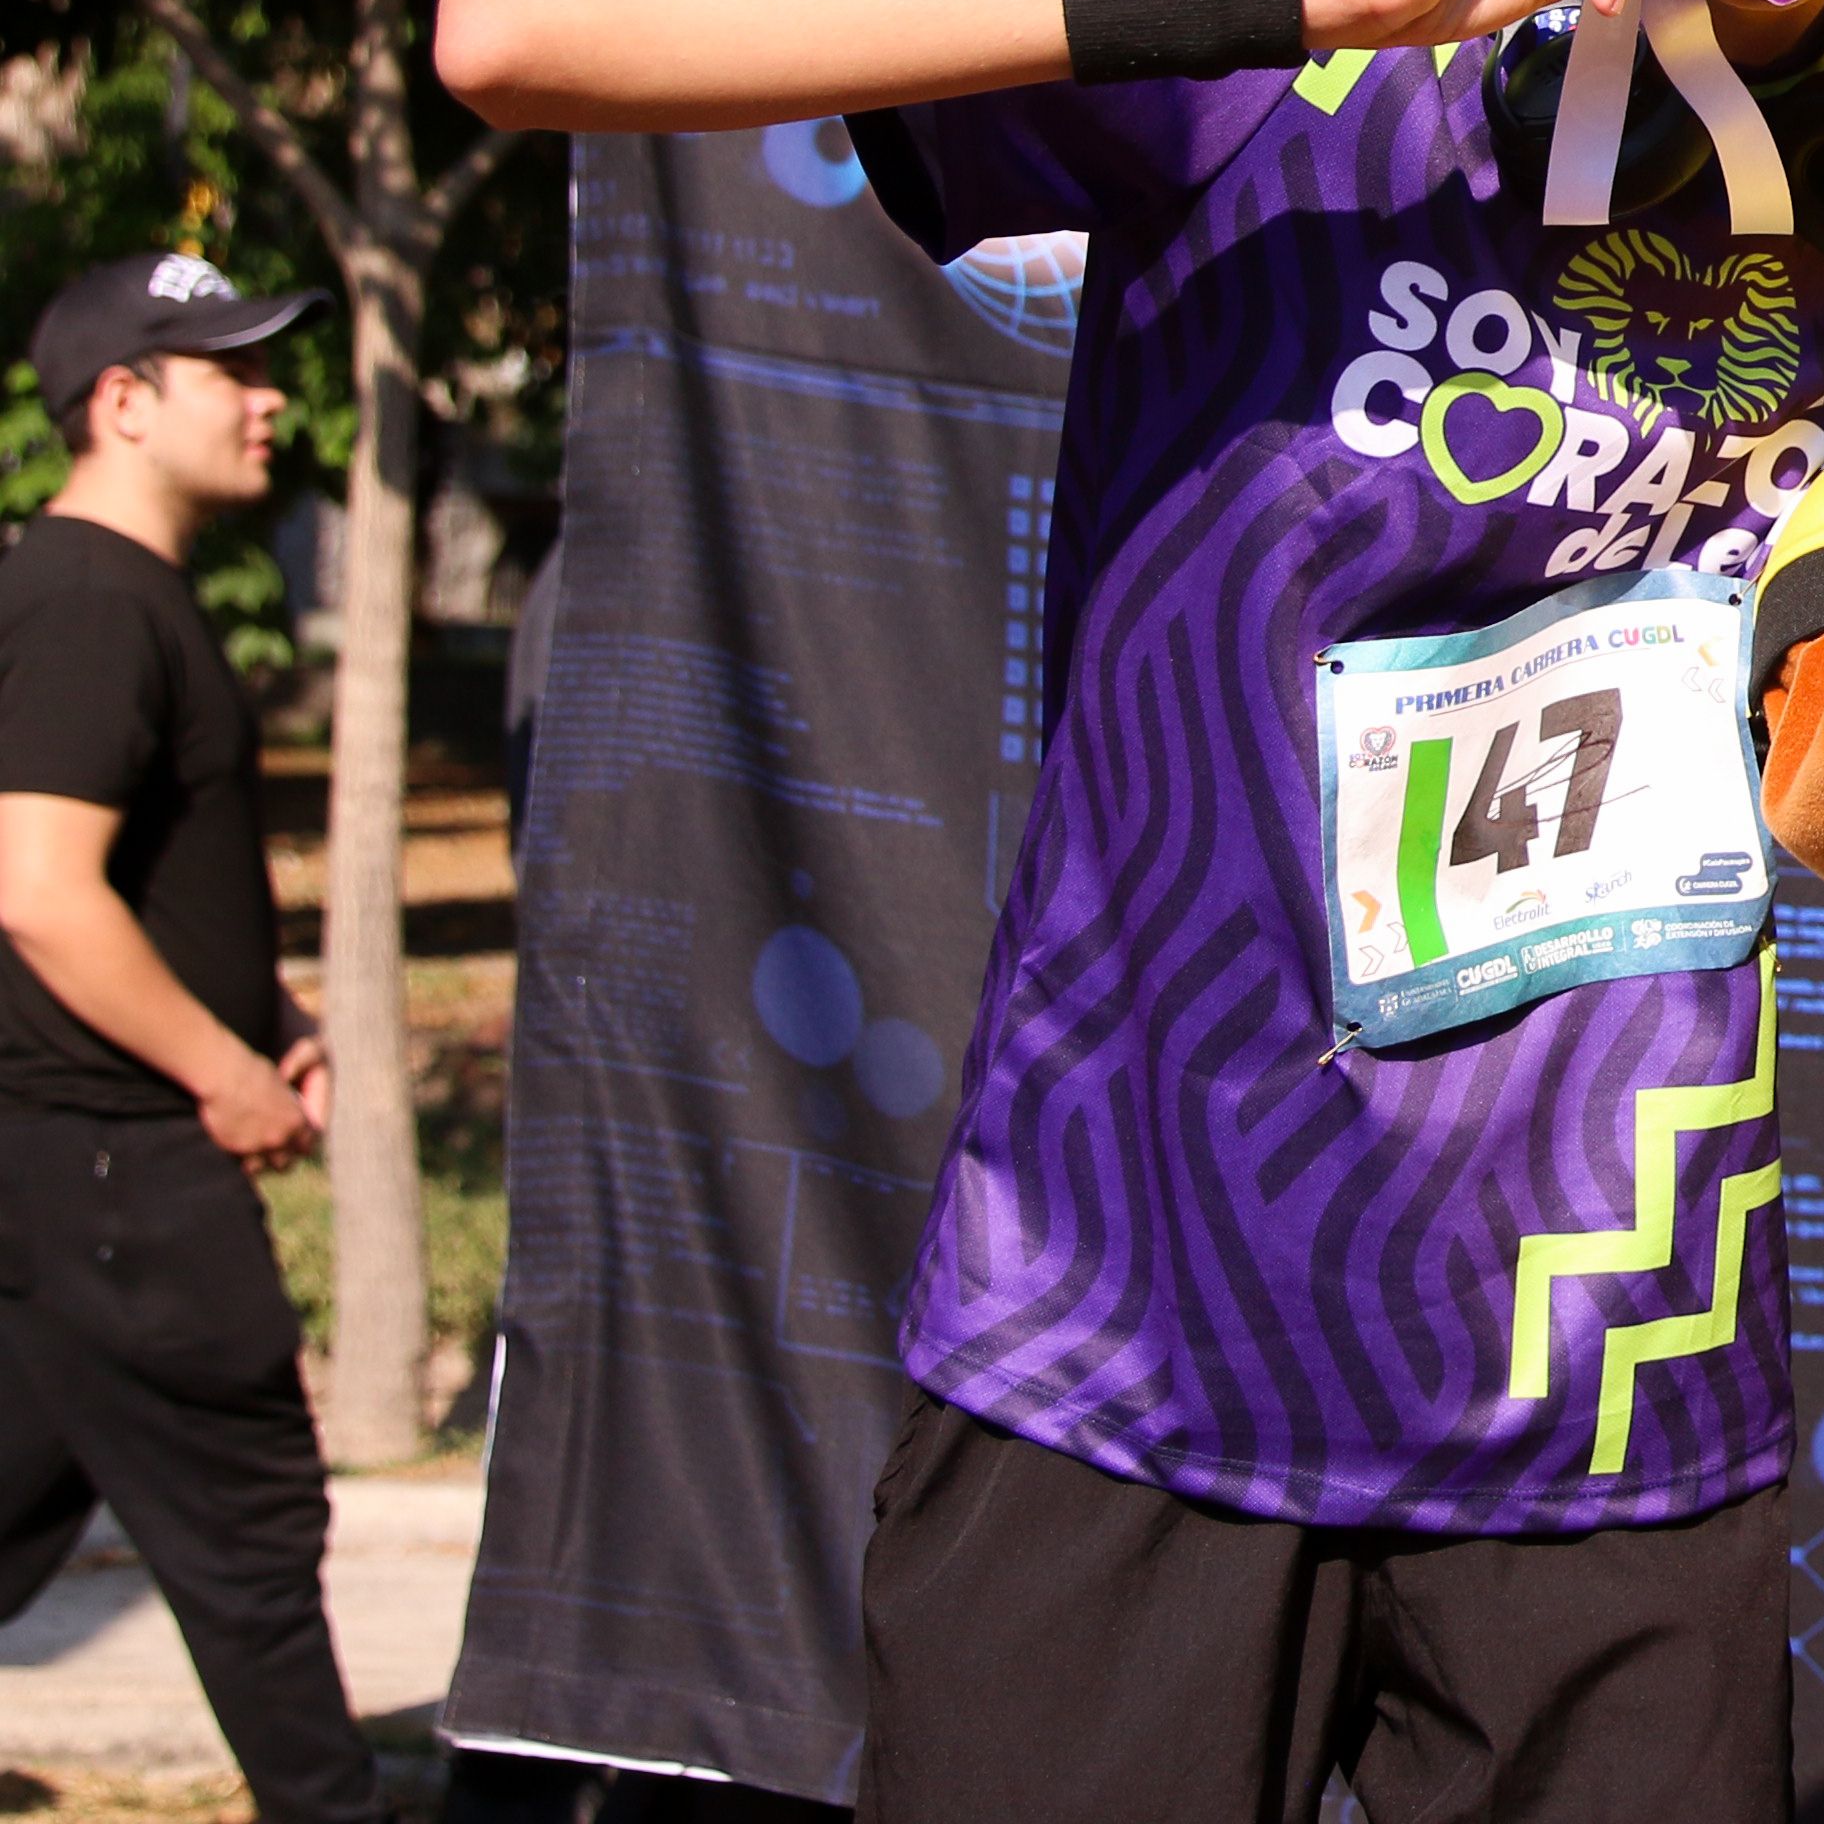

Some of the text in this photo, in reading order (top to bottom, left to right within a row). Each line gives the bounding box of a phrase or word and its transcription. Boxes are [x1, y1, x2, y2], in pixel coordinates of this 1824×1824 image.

[1368, 260, 1584, 405] SOY
[1395, 624, 1685, 715] PRIMERA CARRERA CUGDL
[1449, 687, 1624, 876] 47
[1493, 902, 1552, 931] Electrolit
[1533, 926, 1614, 957] DESARROLLO
[1536, 944, 1593, 969] INTEGRAL
[1456, 955, 1517, 989] CUGDL
